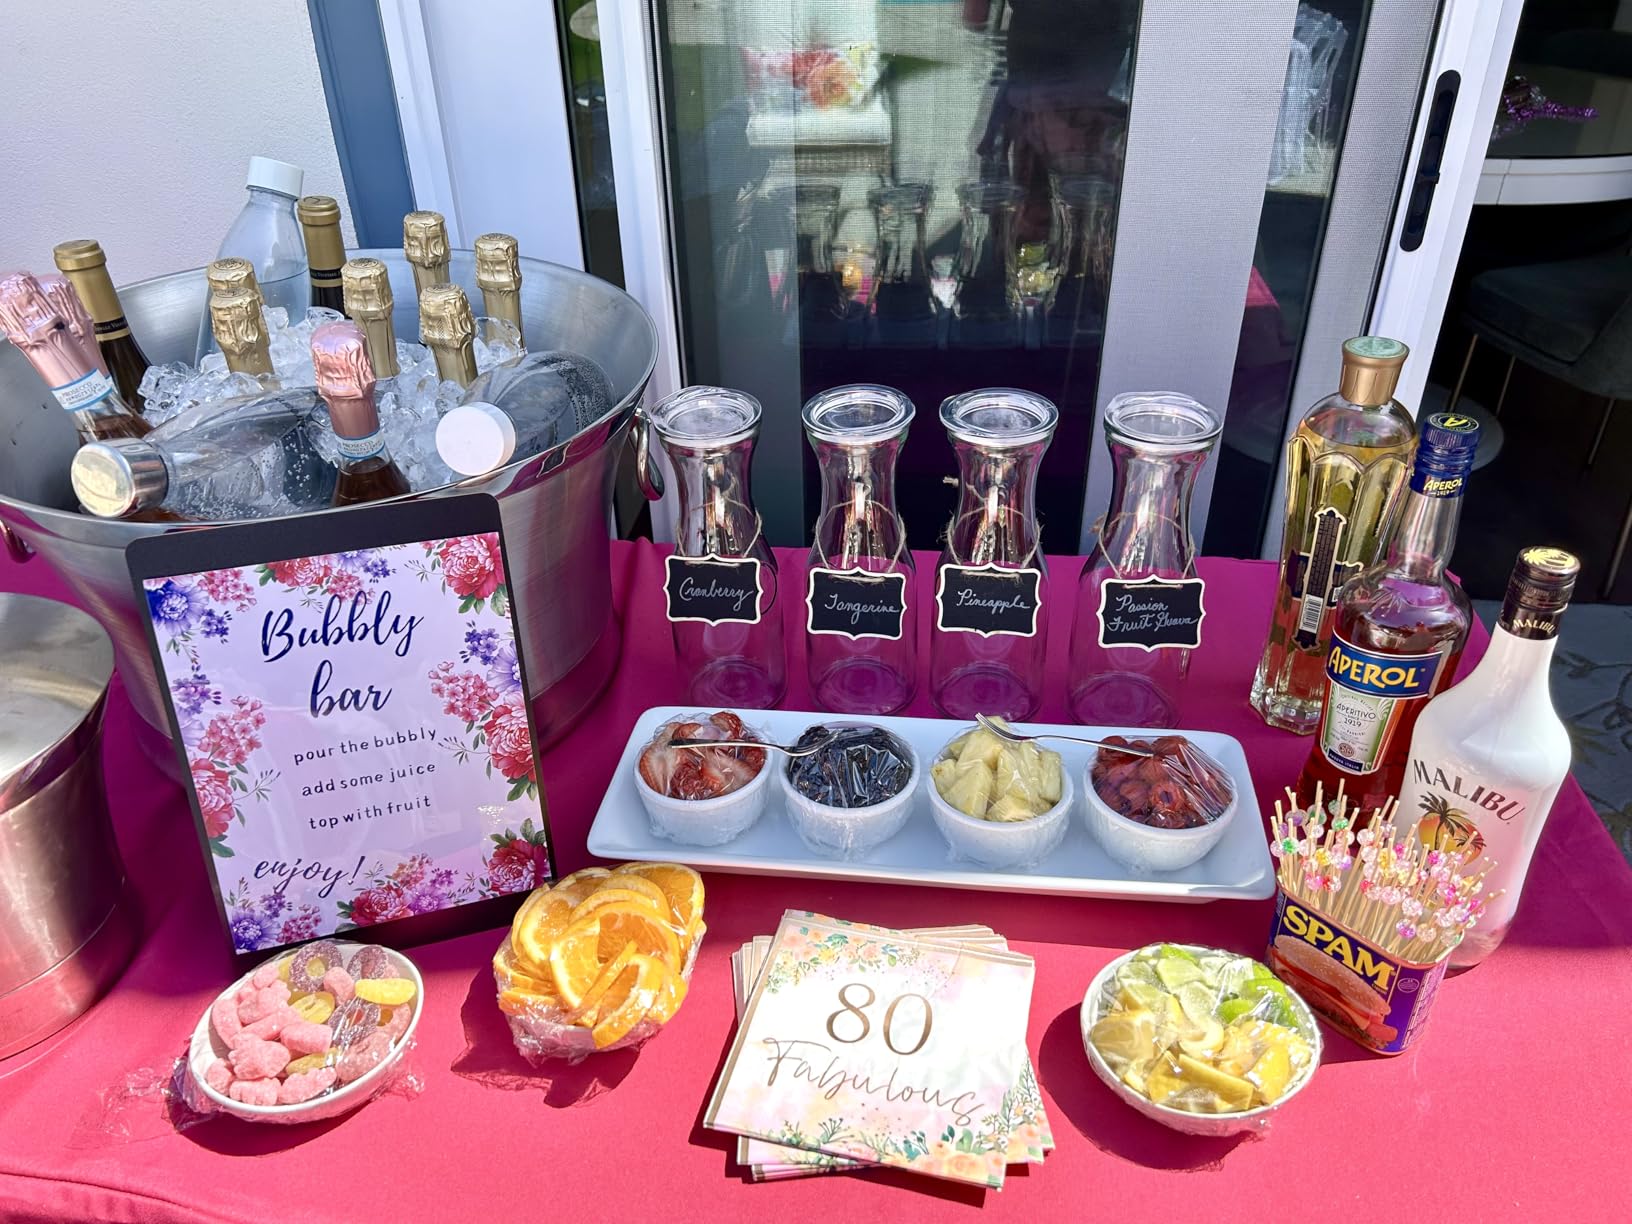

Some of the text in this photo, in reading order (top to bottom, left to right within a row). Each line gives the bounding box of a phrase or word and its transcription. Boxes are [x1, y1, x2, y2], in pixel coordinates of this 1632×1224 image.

[1423, 478, 1463, 491] APEROL
[679, 577, 754, 611] Cranberry
[824, 593, 900, 624] Tangerine
[956, 589, 1030, 615] Pineapple
[1115, 594, 1168, 612] Passion
[261, 590, 424, 663] Bubbly
[1107, 612, 1198, 632] Fruit Guava
[1512, 619, 1556, 634] MALIBU
[1328, 646, 1419, 689] APEROL
[310, 659, 393, 719] bar
[1336, 703, 1376, 720] APERITIVO
[1344, 718, 1362, 727] 1919
[294, 726, 438, 766] pour the bubbly
[302, 760, 436, 797] add some juice
[1413, 759, 1526, 821] MALIBU
[309, 795, 432, 832] top with fruit
[254, 855, 367, 899] enjoy!
[1283, 905, 1395, 990] SPAM
[826, 983, 933, 1056] 80
[763, 1037, 986, 1127] Fabulous
